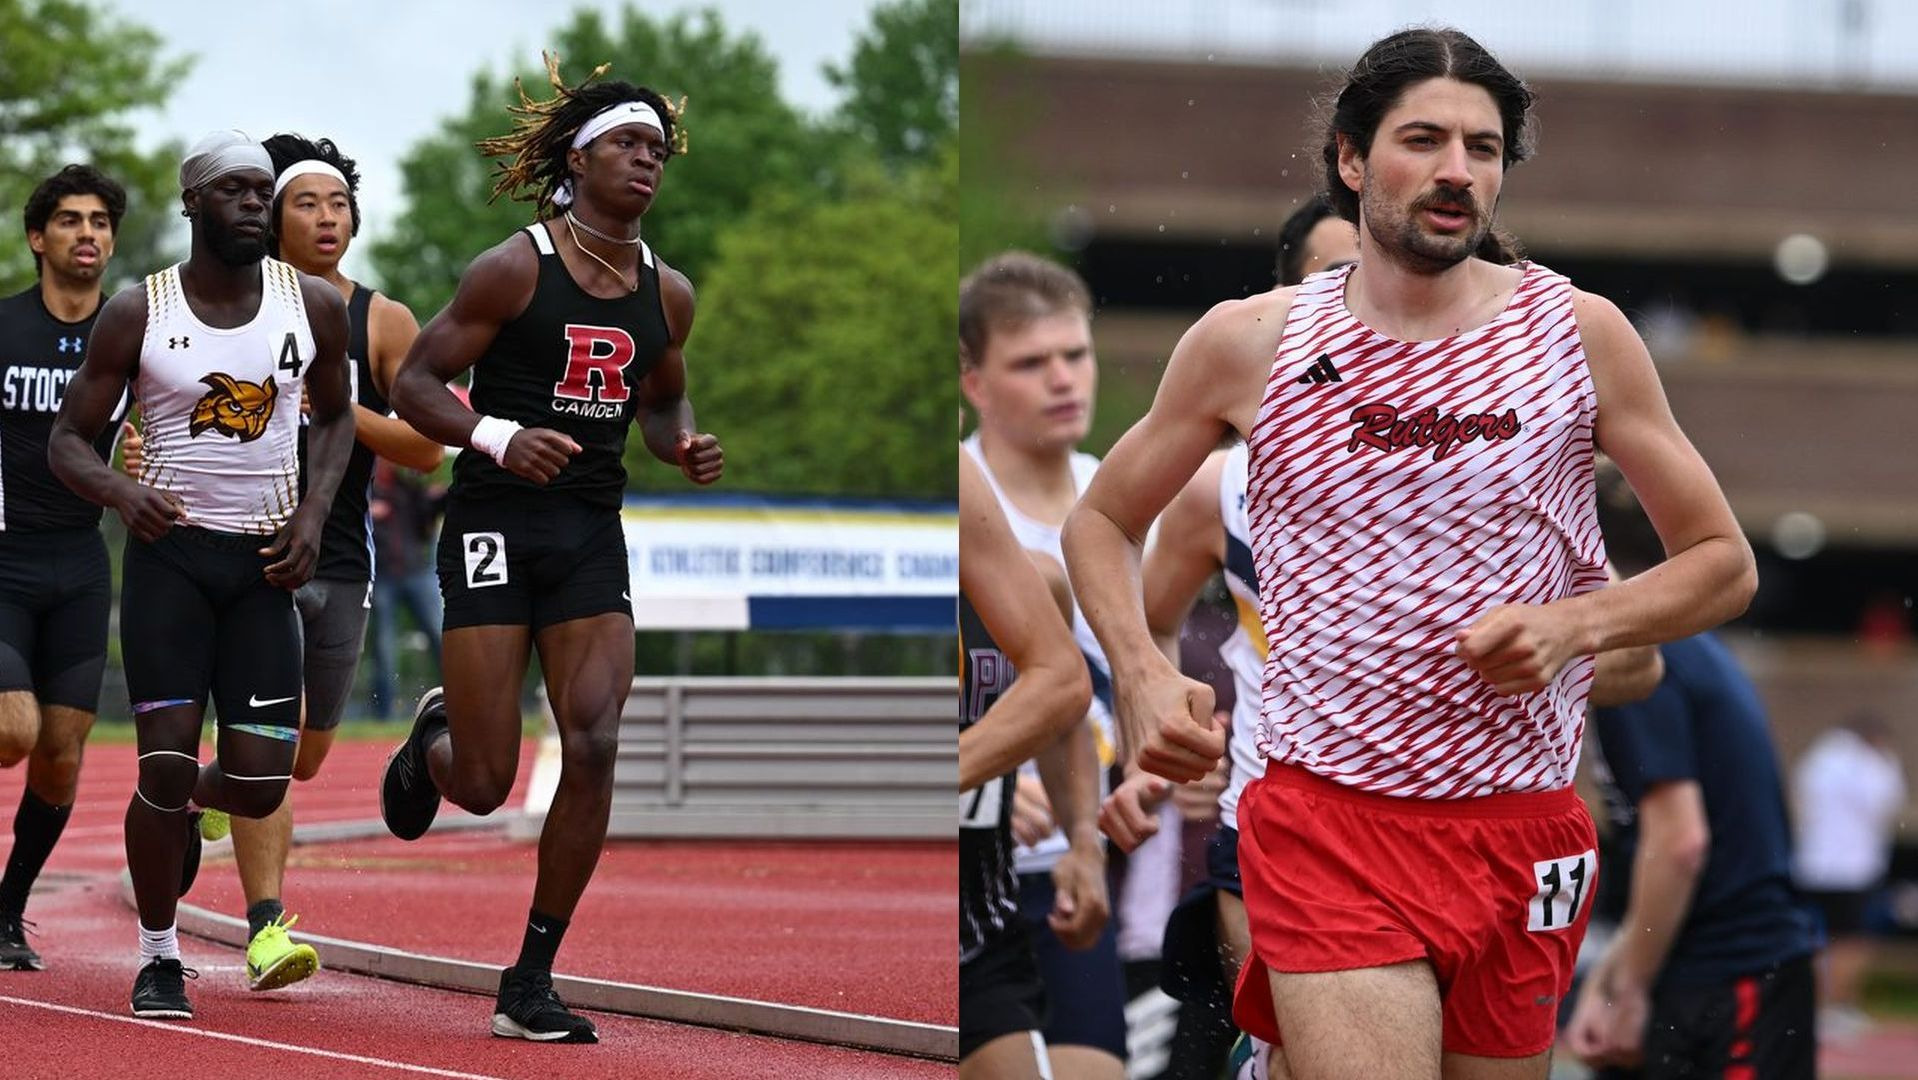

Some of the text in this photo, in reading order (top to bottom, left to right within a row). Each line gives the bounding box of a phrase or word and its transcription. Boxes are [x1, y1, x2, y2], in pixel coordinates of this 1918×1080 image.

[278, 332, 303, 378] 4
[554, 324, 636, 403] R
[551, 398, 624, 419] CAMDEN
[1347, 403, 1522, 462] Rutgers
[469, 535, 501, 584] 2
[1541, 857, 1585, 927] 11
